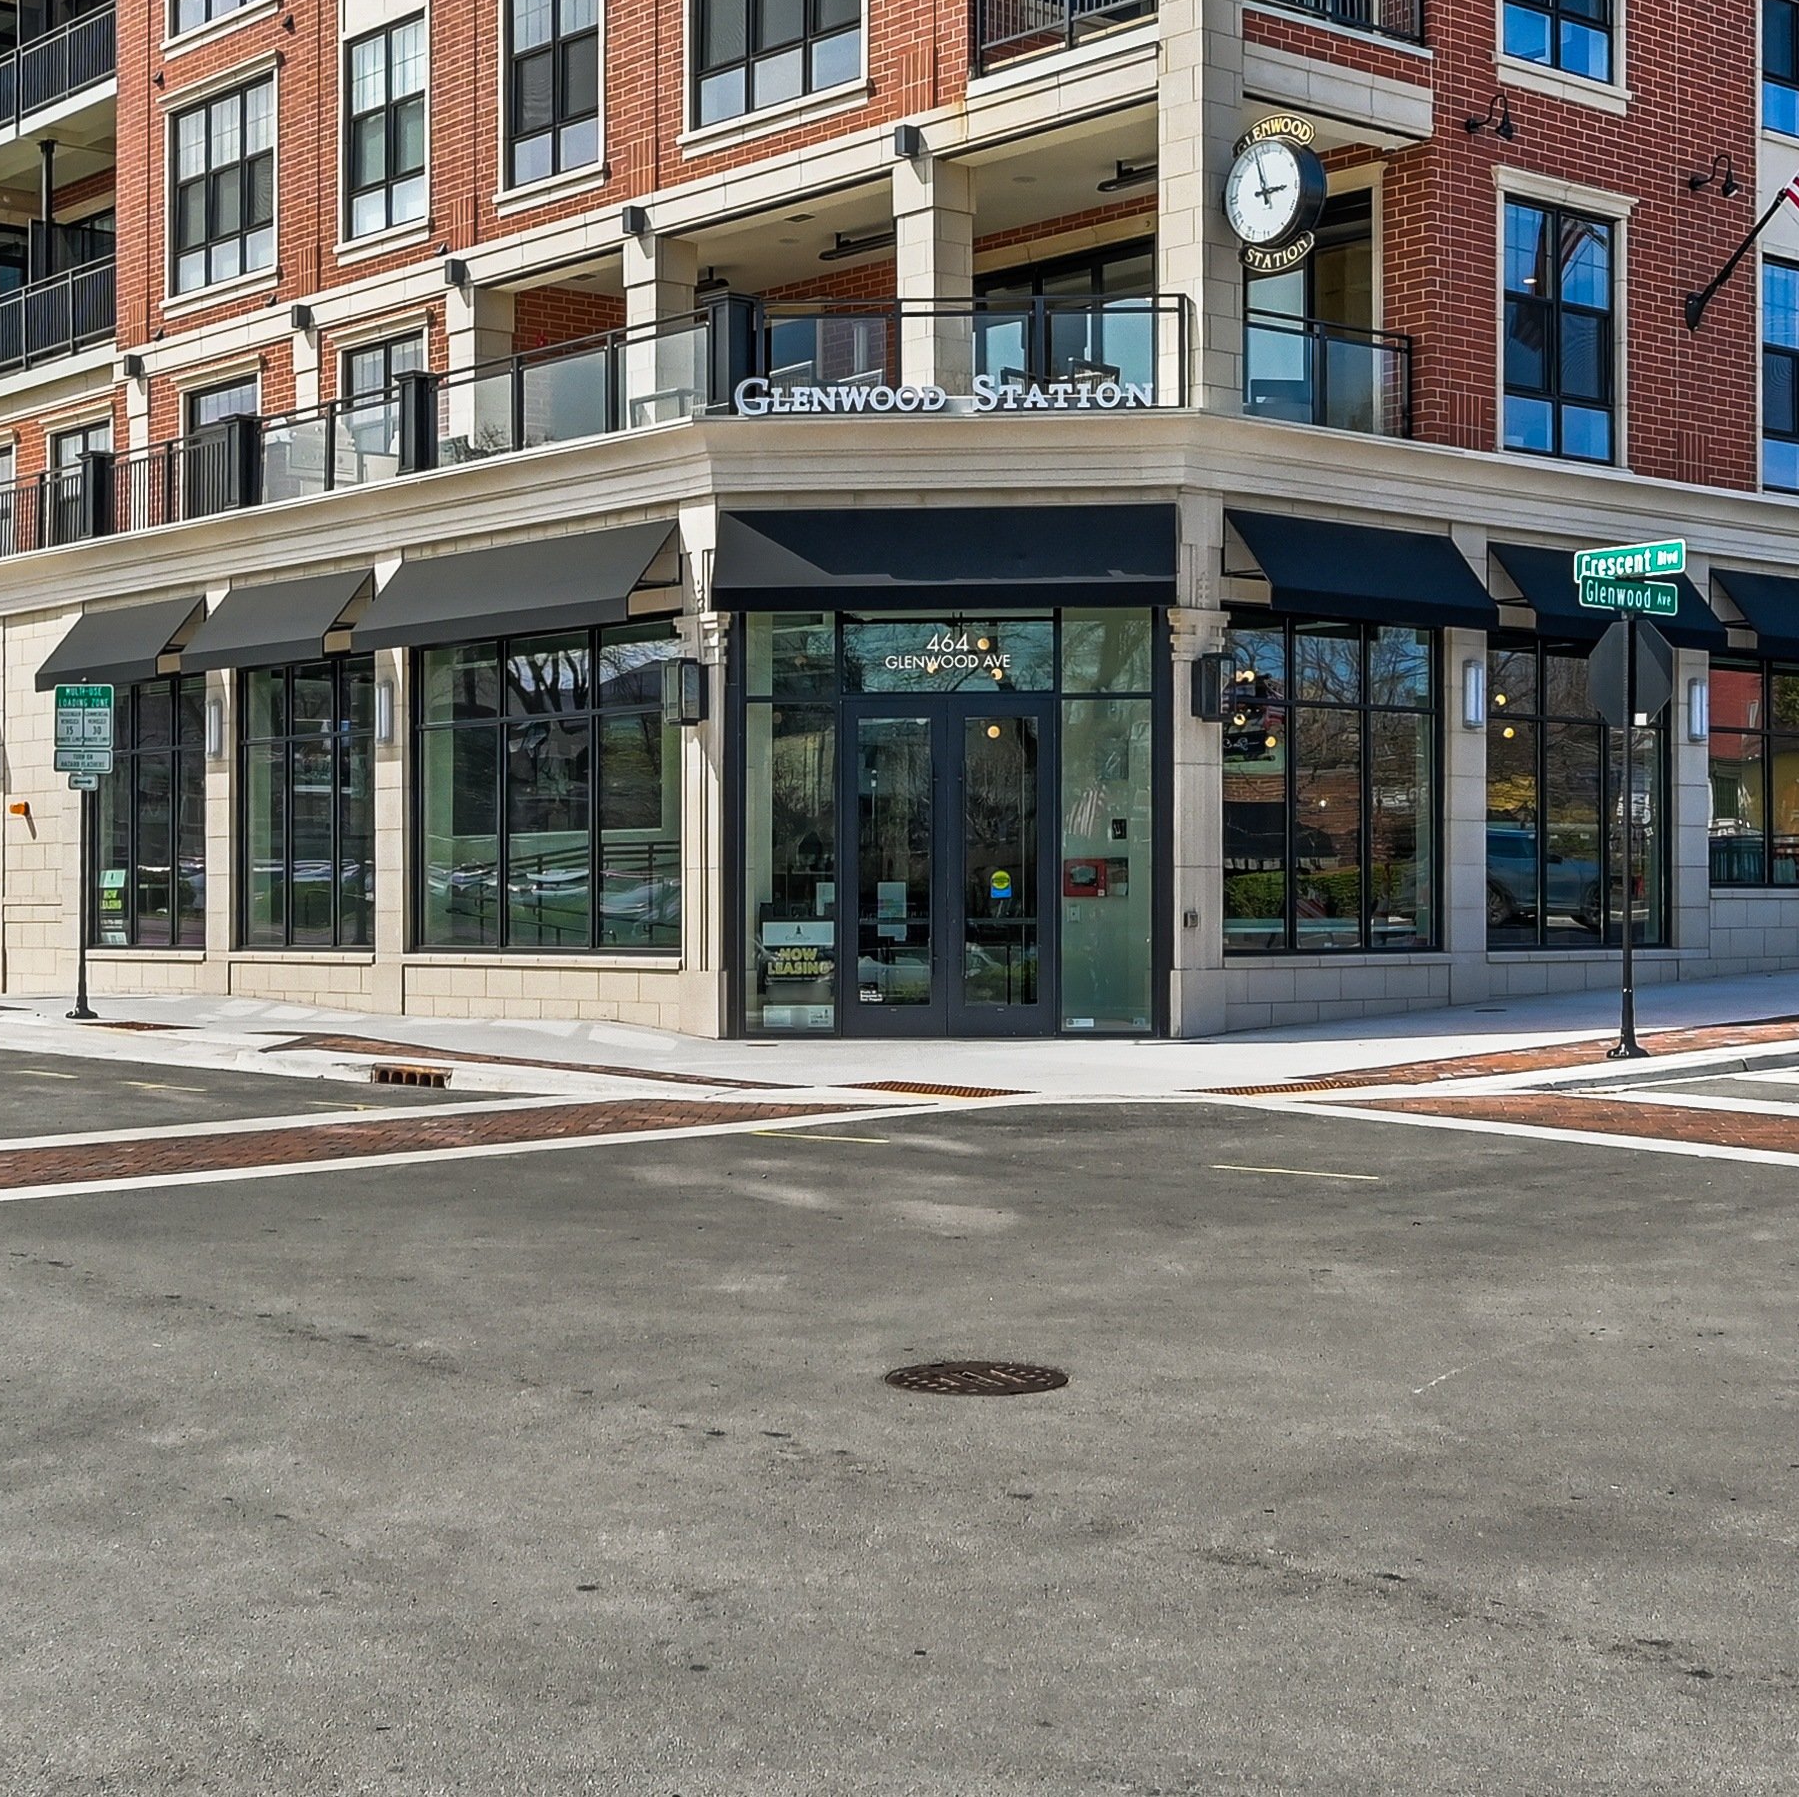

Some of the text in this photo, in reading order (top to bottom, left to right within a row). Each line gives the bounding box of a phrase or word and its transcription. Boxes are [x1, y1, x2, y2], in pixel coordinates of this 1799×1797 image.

[1237, 117, 1311, 154] GLENWOOD
[1244, 238, 1309, 269] STATION
[734, 374, 1154, 416] GLENWOOD STATION
[1581, 548, 1679, 577] Crescent Blvd
[1586, 579, 1672, 609] Glenwood Ave
[926, 633, 969, 652] 464
[885, 654, 1011, 669] GLENWOOD AVE
[58, 698, 109, 708] LOADING ZONE
[65, 726, 74, 735] 15
[92, 726, 102, 735] 30
[779, 947, 818, 961] NOW
[767, 961, 831, 975] LEASING
